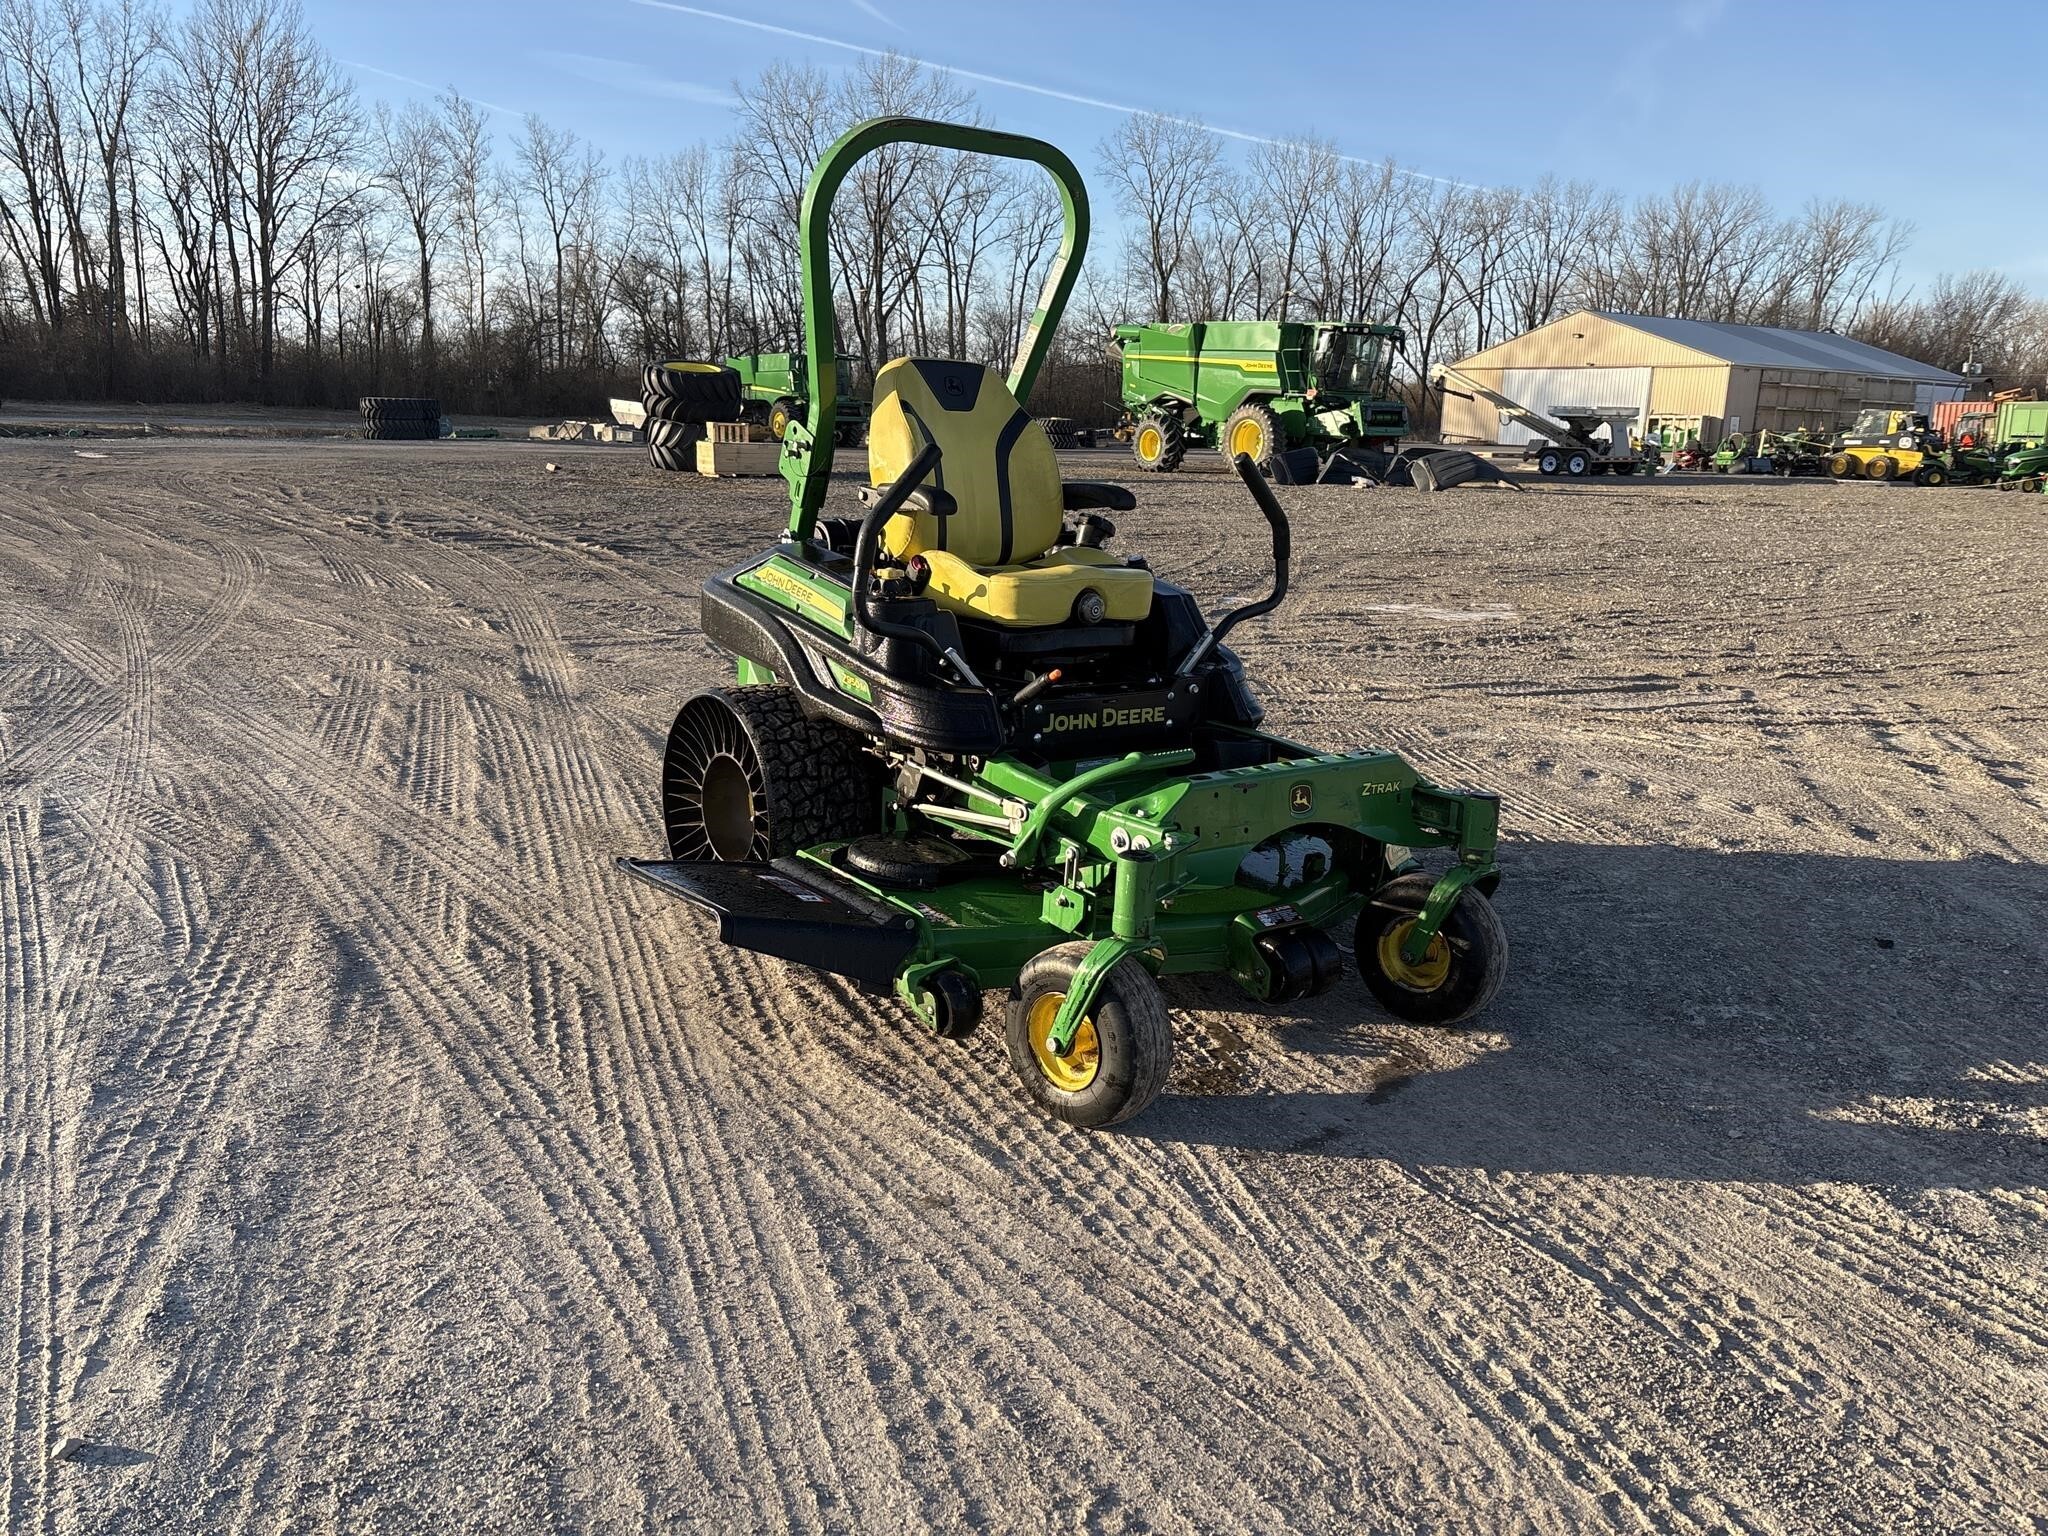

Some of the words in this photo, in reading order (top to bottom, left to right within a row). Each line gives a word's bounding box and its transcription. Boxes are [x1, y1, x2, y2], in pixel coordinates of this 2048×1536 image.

[763, 570, 785, 588] JOHN
[785, 580, 813, 602] DEERE
[1042, 713, 1097, 733] JOHN
[1102, 707, 1166, 727] DEERE
[1362, 781, 1400, 796] ZTRAK
